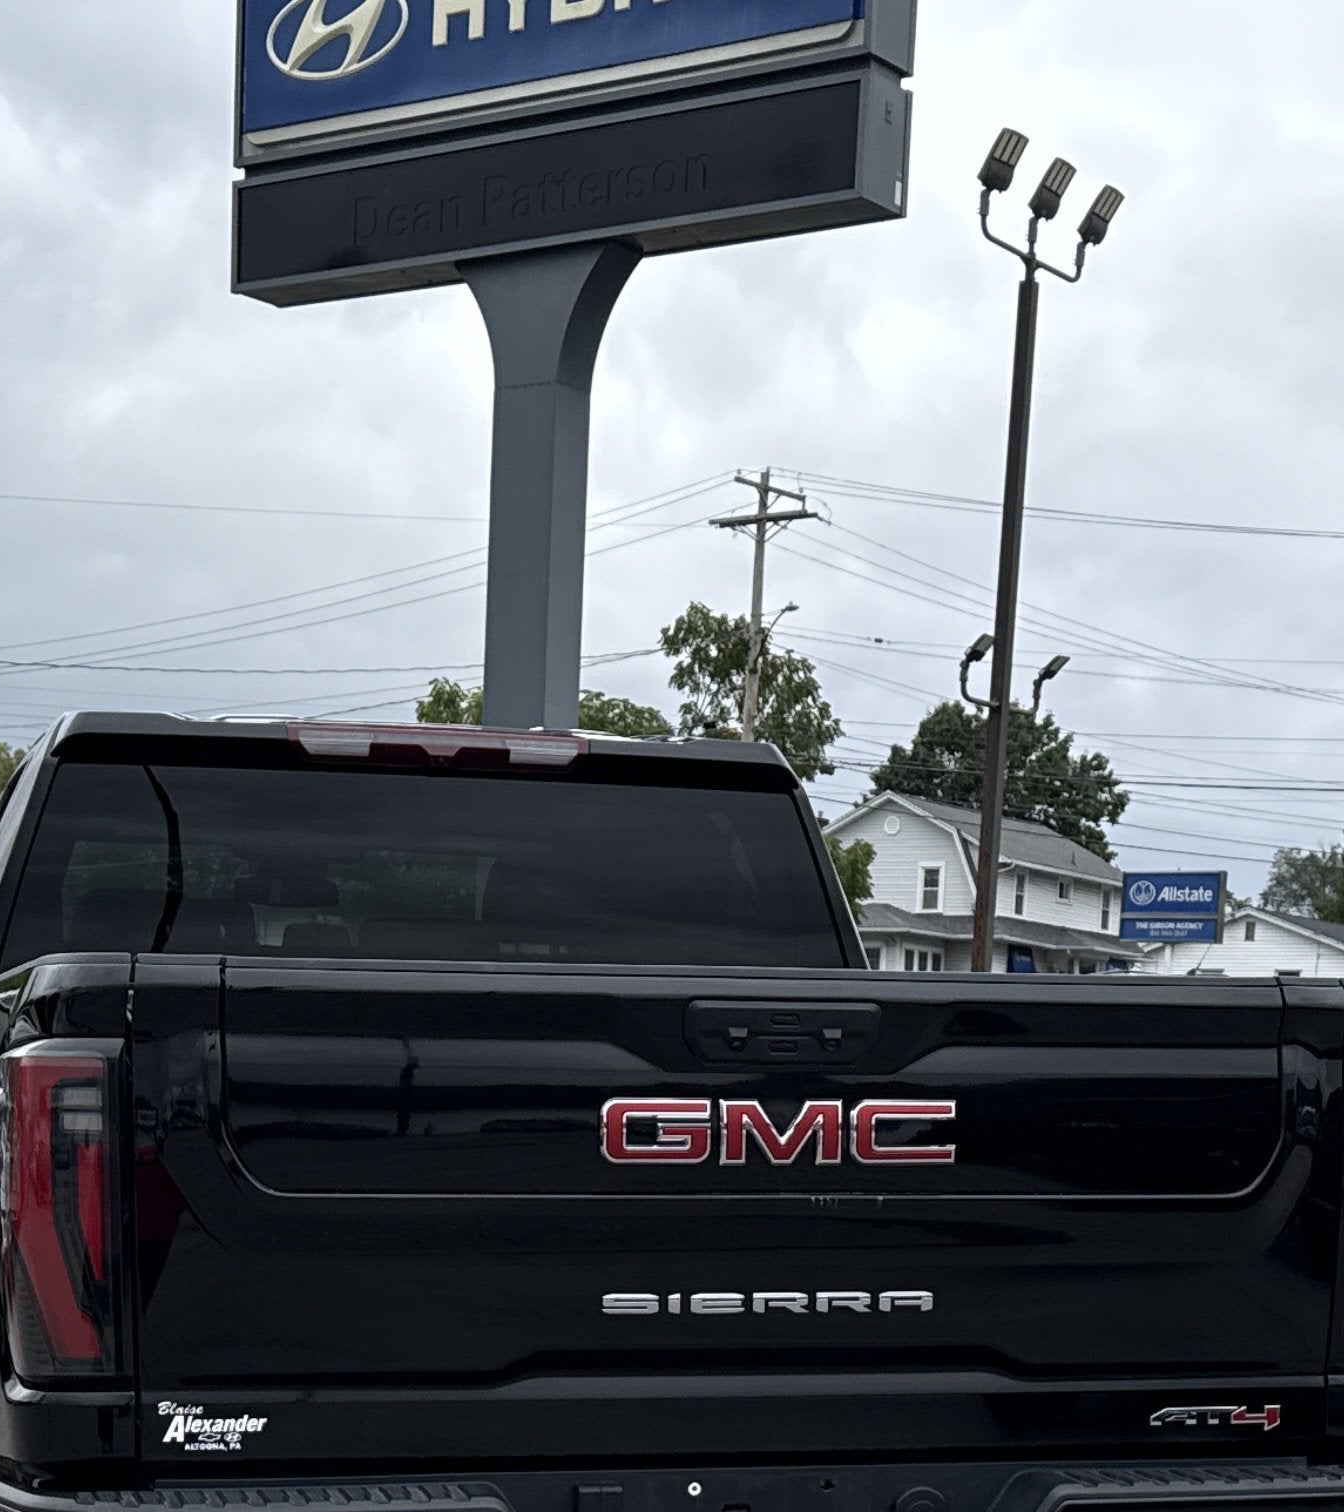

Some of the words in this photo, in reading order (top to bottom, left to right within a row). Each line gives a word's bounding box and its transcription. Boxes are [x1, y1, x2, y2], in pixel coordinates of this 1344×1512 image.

[351, 192, 461, 247] Dean
[480, 152, 711, 227] Patterson
[1157, 886, 1214, 902] Allstate
[601, 1097, 956, 1165] GMC
[601, 1290, 934, 1315] SIERRA
[157, 1401, 204, 1416] Blaise
[1150, 1405, 1281, 1431] AT4
[162, 1414, 268, 1442] Alexander
[229, 1442, 242, 1450] PA
